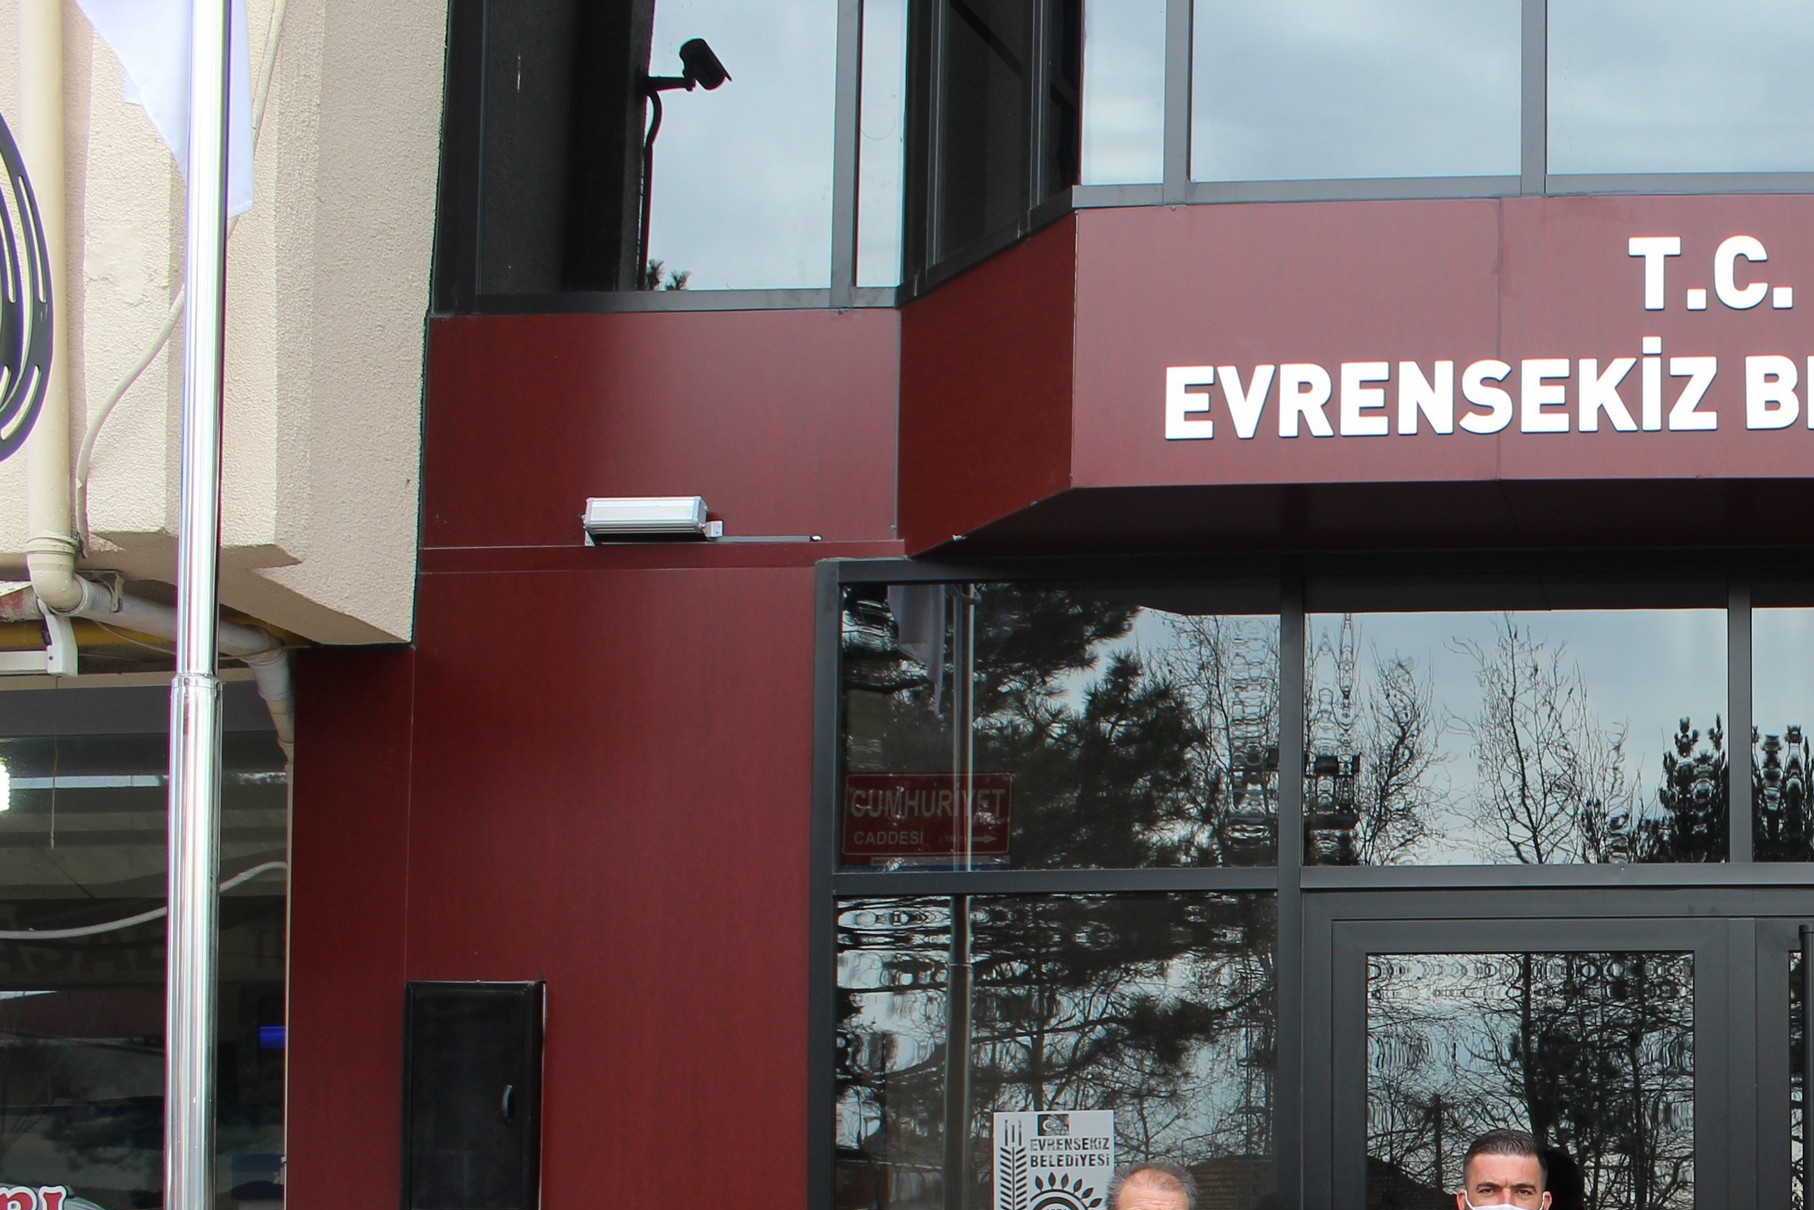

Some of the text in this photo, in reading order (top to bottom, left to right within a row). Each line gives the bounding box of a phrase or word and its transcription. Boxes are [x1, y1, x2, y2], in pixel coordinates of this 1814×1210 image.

[1628, 235, 1795, 311] T.C.
[1163, 336, 1718, 442] EVRENSEKİZ
[1030, 1137, 1110, 1151] EVRENSEKİZ
[1030, 1153, 1110, 1168] BELEDİYESİ
